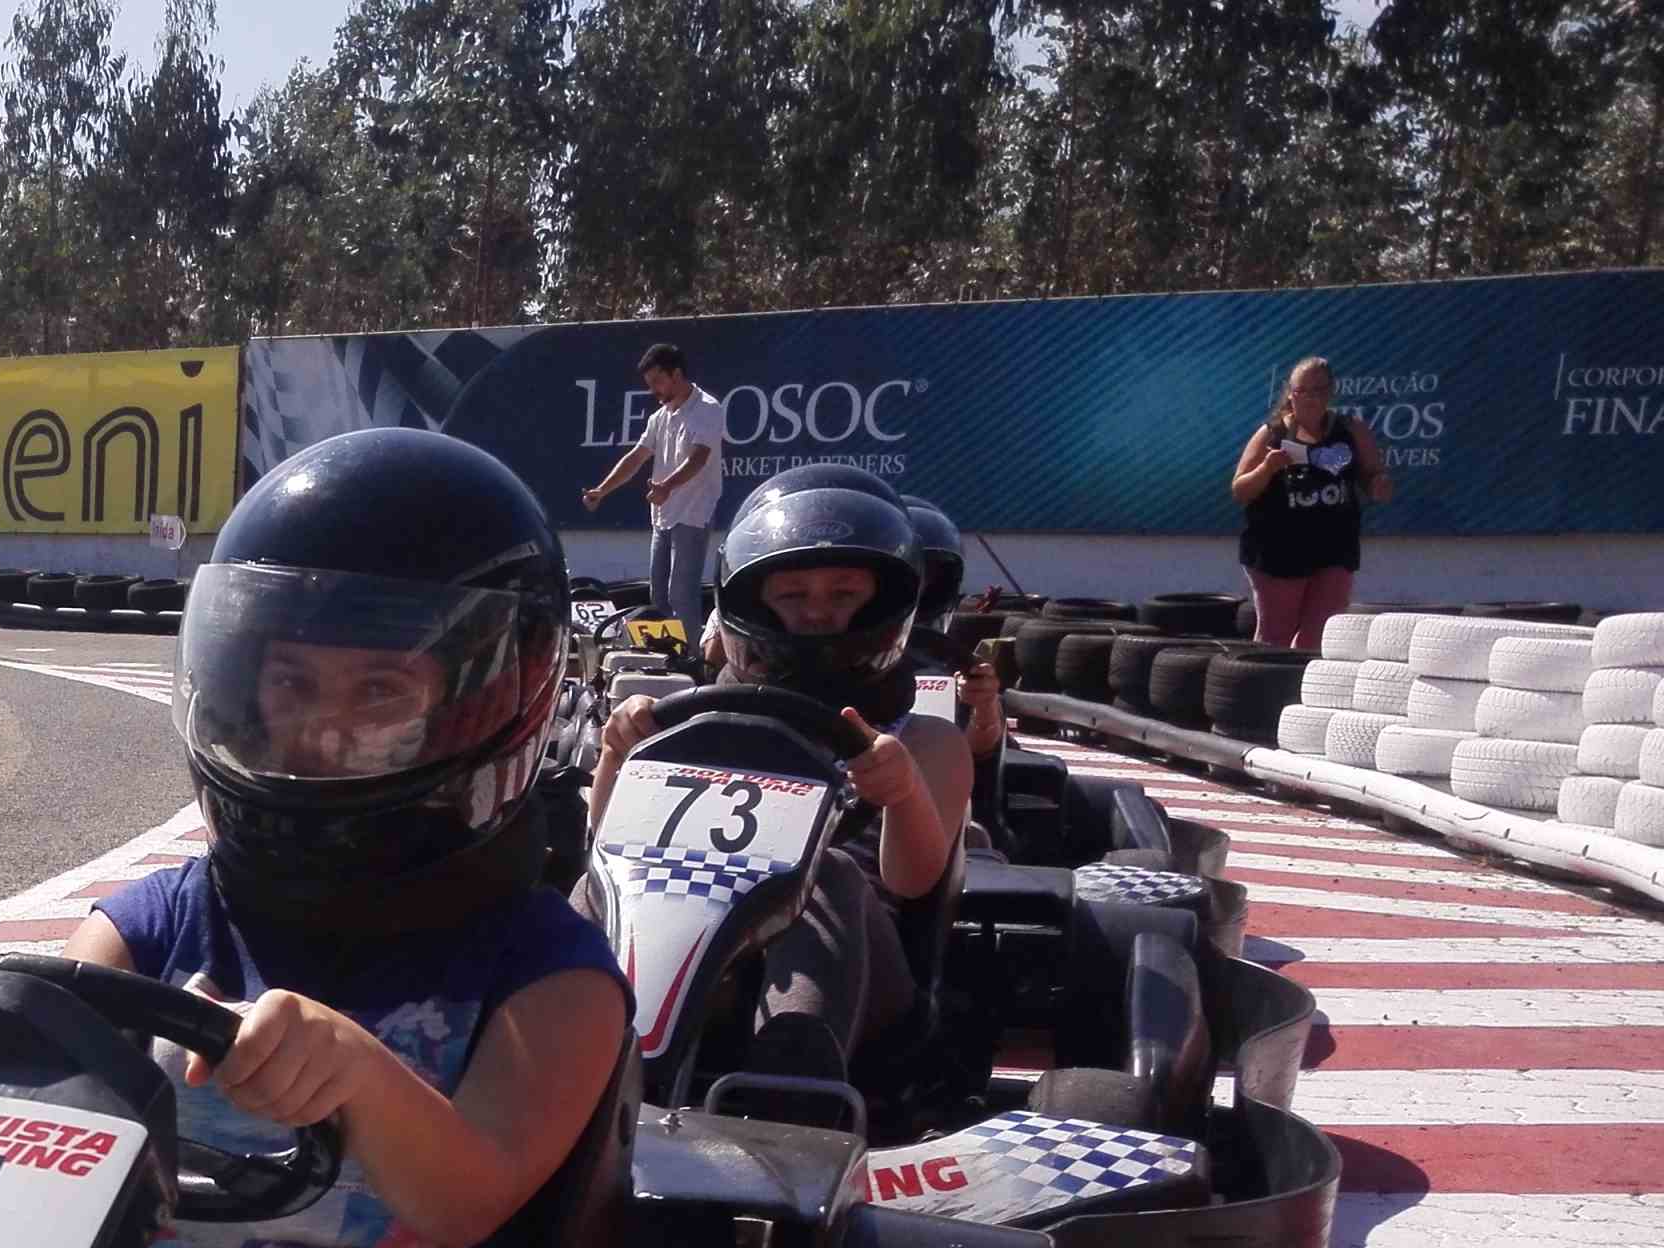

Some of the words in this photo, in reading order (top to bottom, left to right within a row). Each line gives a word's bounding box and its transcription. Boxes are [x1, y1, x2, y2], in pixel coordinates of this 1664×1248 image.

[1334, 370, 1440, 397] RIZAÇÃO
[3, 361, 205, 522] eni
[721, 456, 786, 476] ARKET
[655, 775, 763, 854] 73
